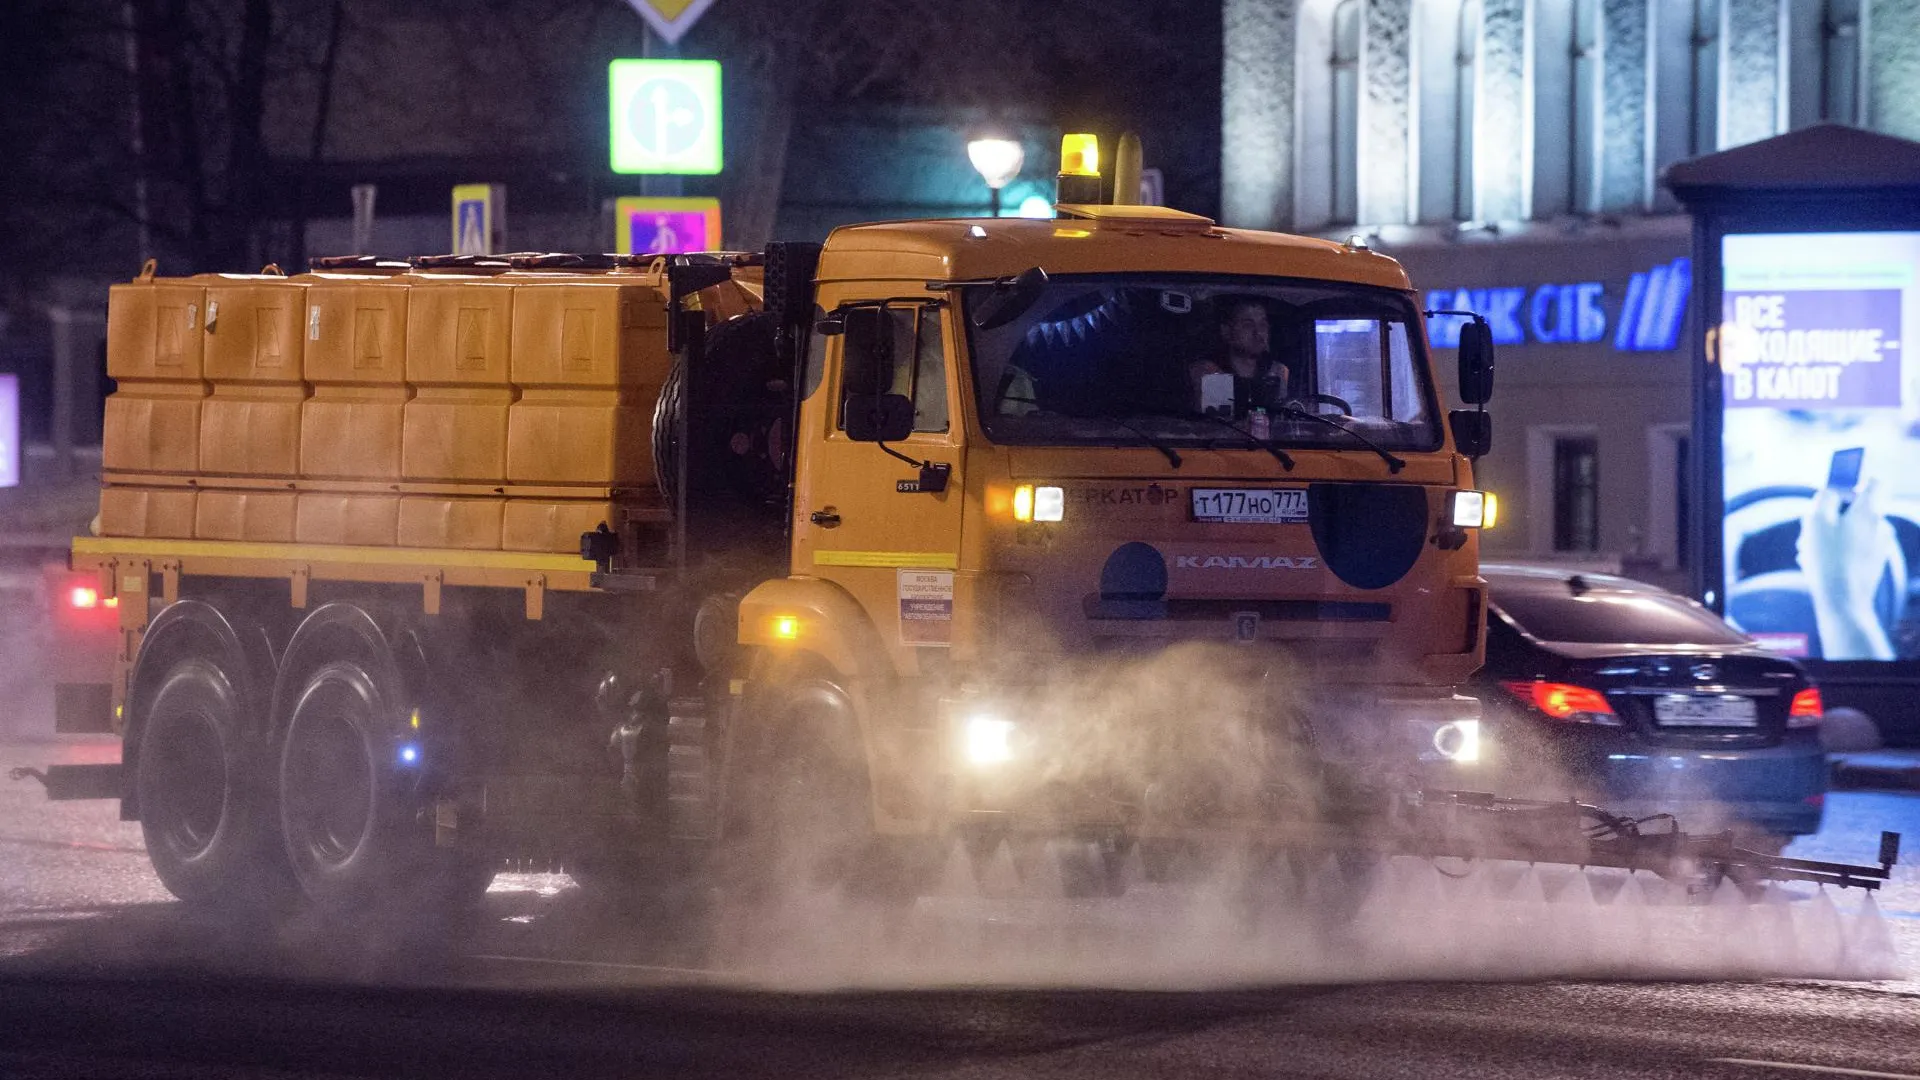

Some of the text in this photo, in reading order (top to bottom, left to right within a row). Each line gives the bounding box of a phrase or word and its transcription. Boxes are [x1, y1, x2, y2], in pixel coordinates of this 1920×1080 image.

[1427, 287, 1525, 347] БАНК
[1735, 296, 1785, 328] ВСЕ
[1734, 366, 1842, 400] В КАПОТ
[898, 483, 920, 491] 6511
[1176, 556, 1318, 569] KAMAZ
